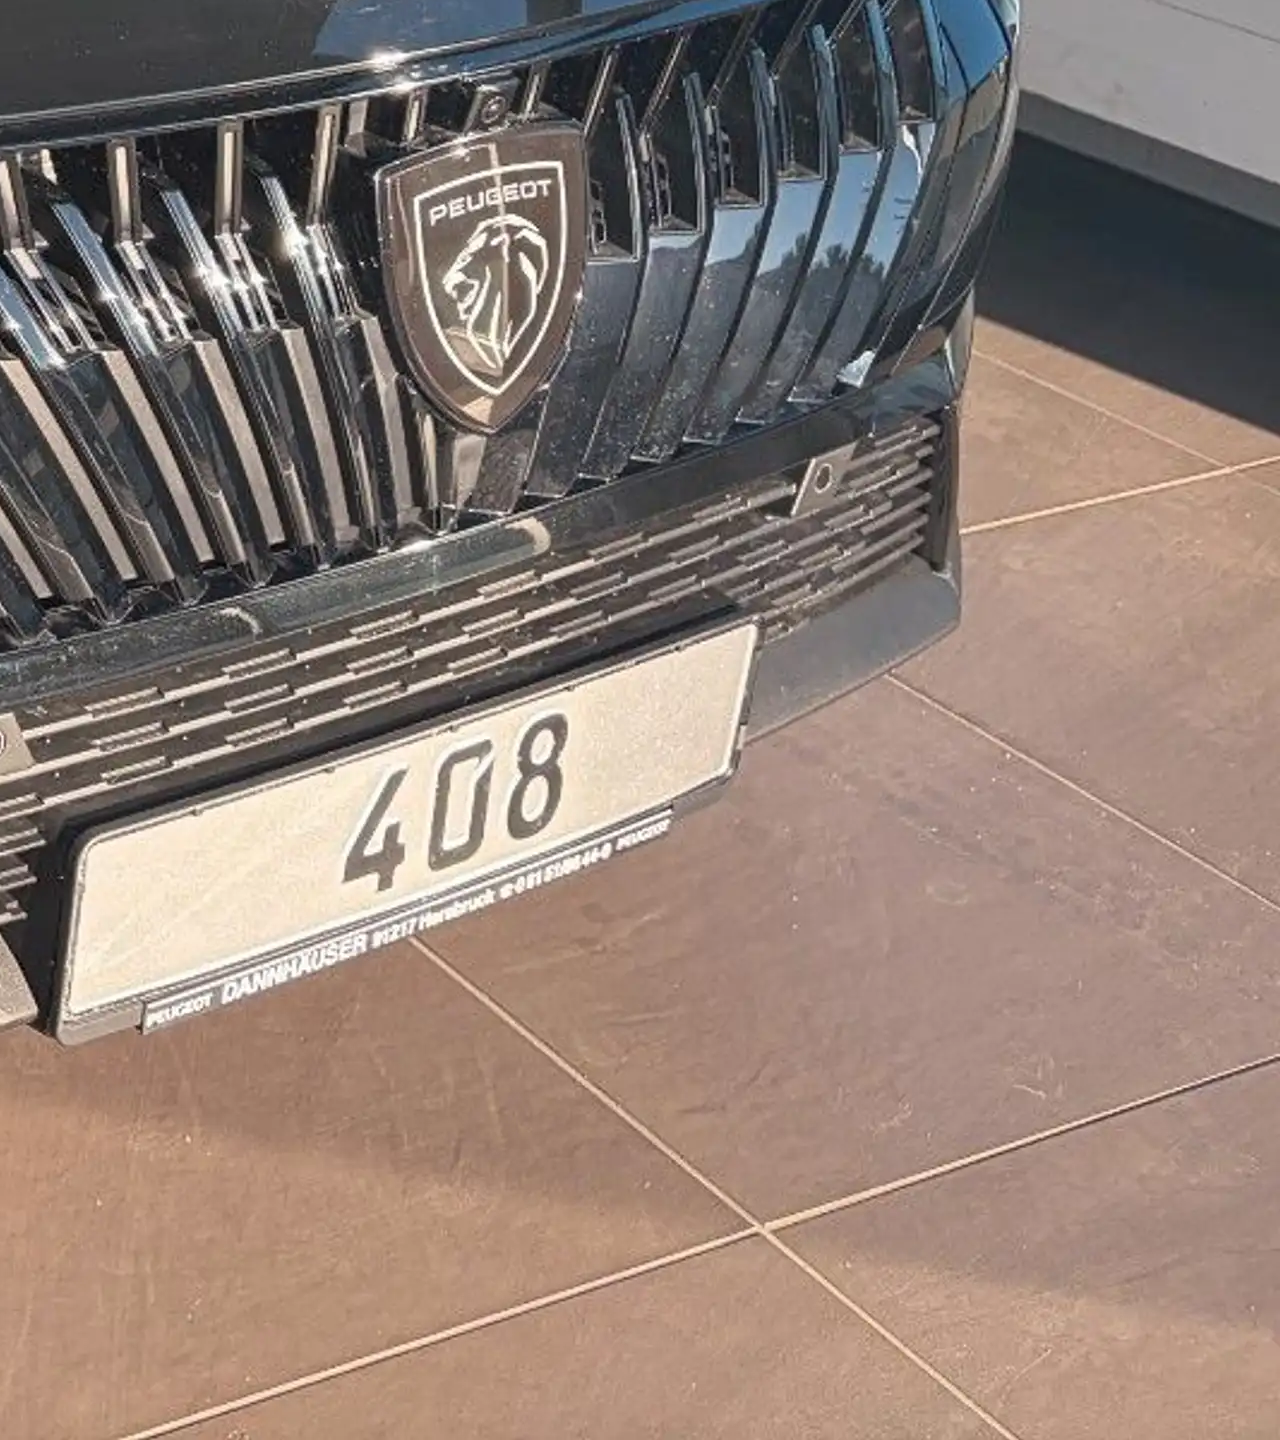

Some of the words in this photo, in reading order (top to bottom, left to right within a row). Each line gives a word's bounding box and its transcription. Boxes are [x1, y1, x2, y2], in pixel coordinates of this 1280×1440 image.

[428, 178, 552, 227] PEUGEOT
[341, 712, 569, 892] 408
[145, 992, 214, 1029] PEUGEOT
